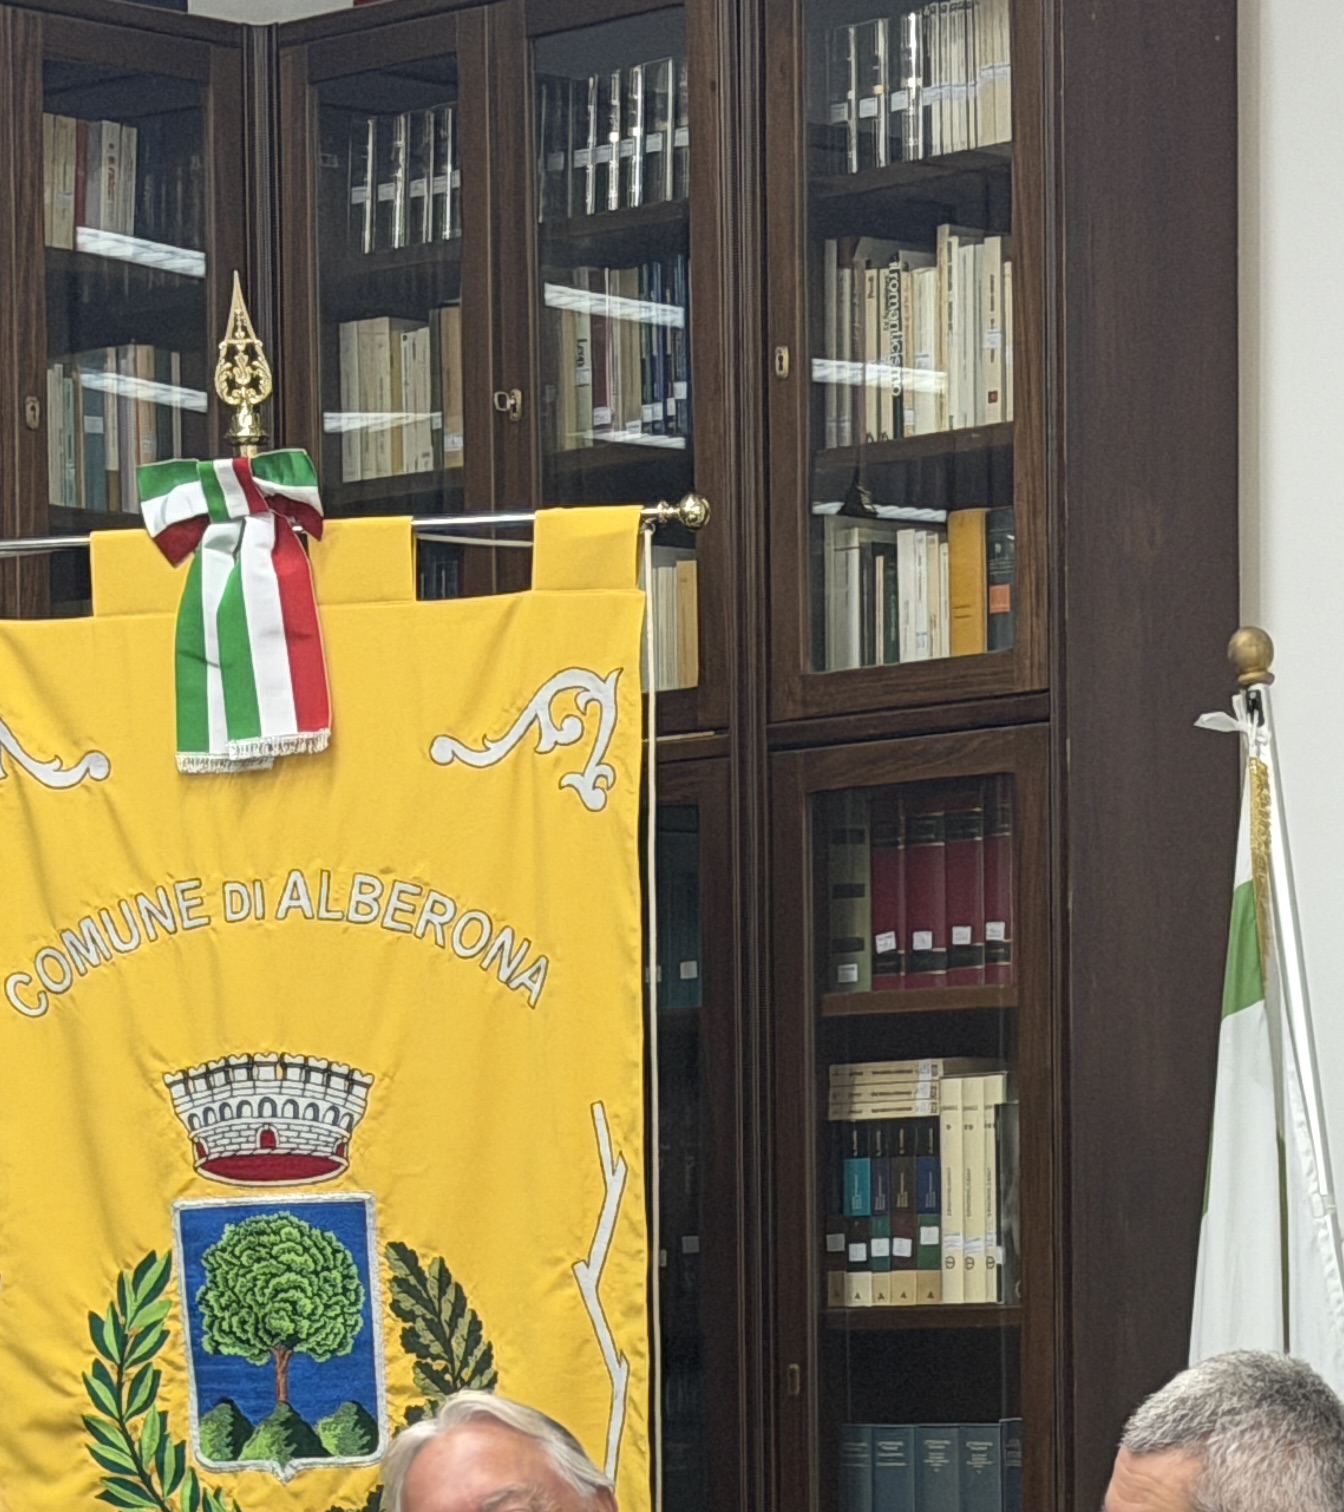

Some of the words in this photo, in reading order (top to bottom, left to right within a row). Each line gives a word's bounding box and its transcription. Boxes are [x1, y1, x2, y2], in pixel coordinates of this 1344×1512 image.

[4, 877, 210, 1018] COMUNE
[222, 880, 266, 924] DI
[276, 869, 549, 1009] ALBERONA
